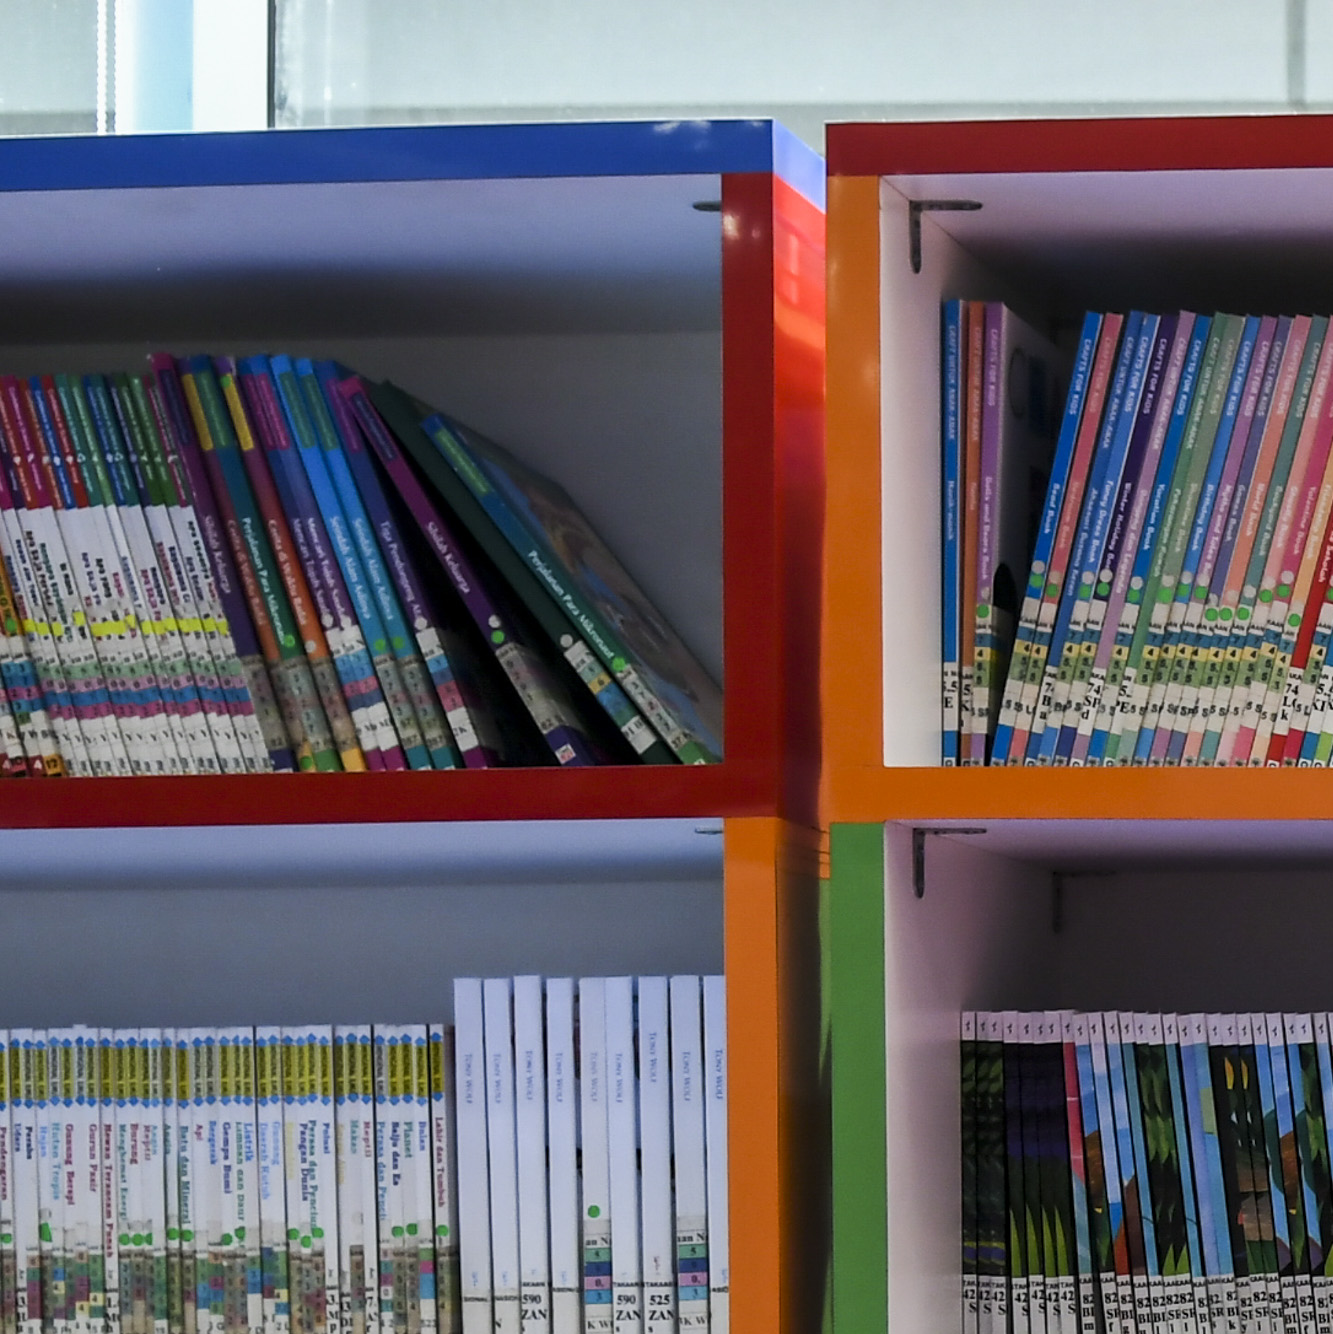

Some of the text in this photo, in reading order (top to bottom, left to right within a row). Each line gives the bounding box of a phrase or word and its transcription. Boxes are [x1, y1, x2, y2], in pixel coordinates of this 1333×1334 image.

[522, 1294, 542, 1305] 590
[617, 1294, 636, 1305] 590
[650, 1294, 670, 1305] 525
